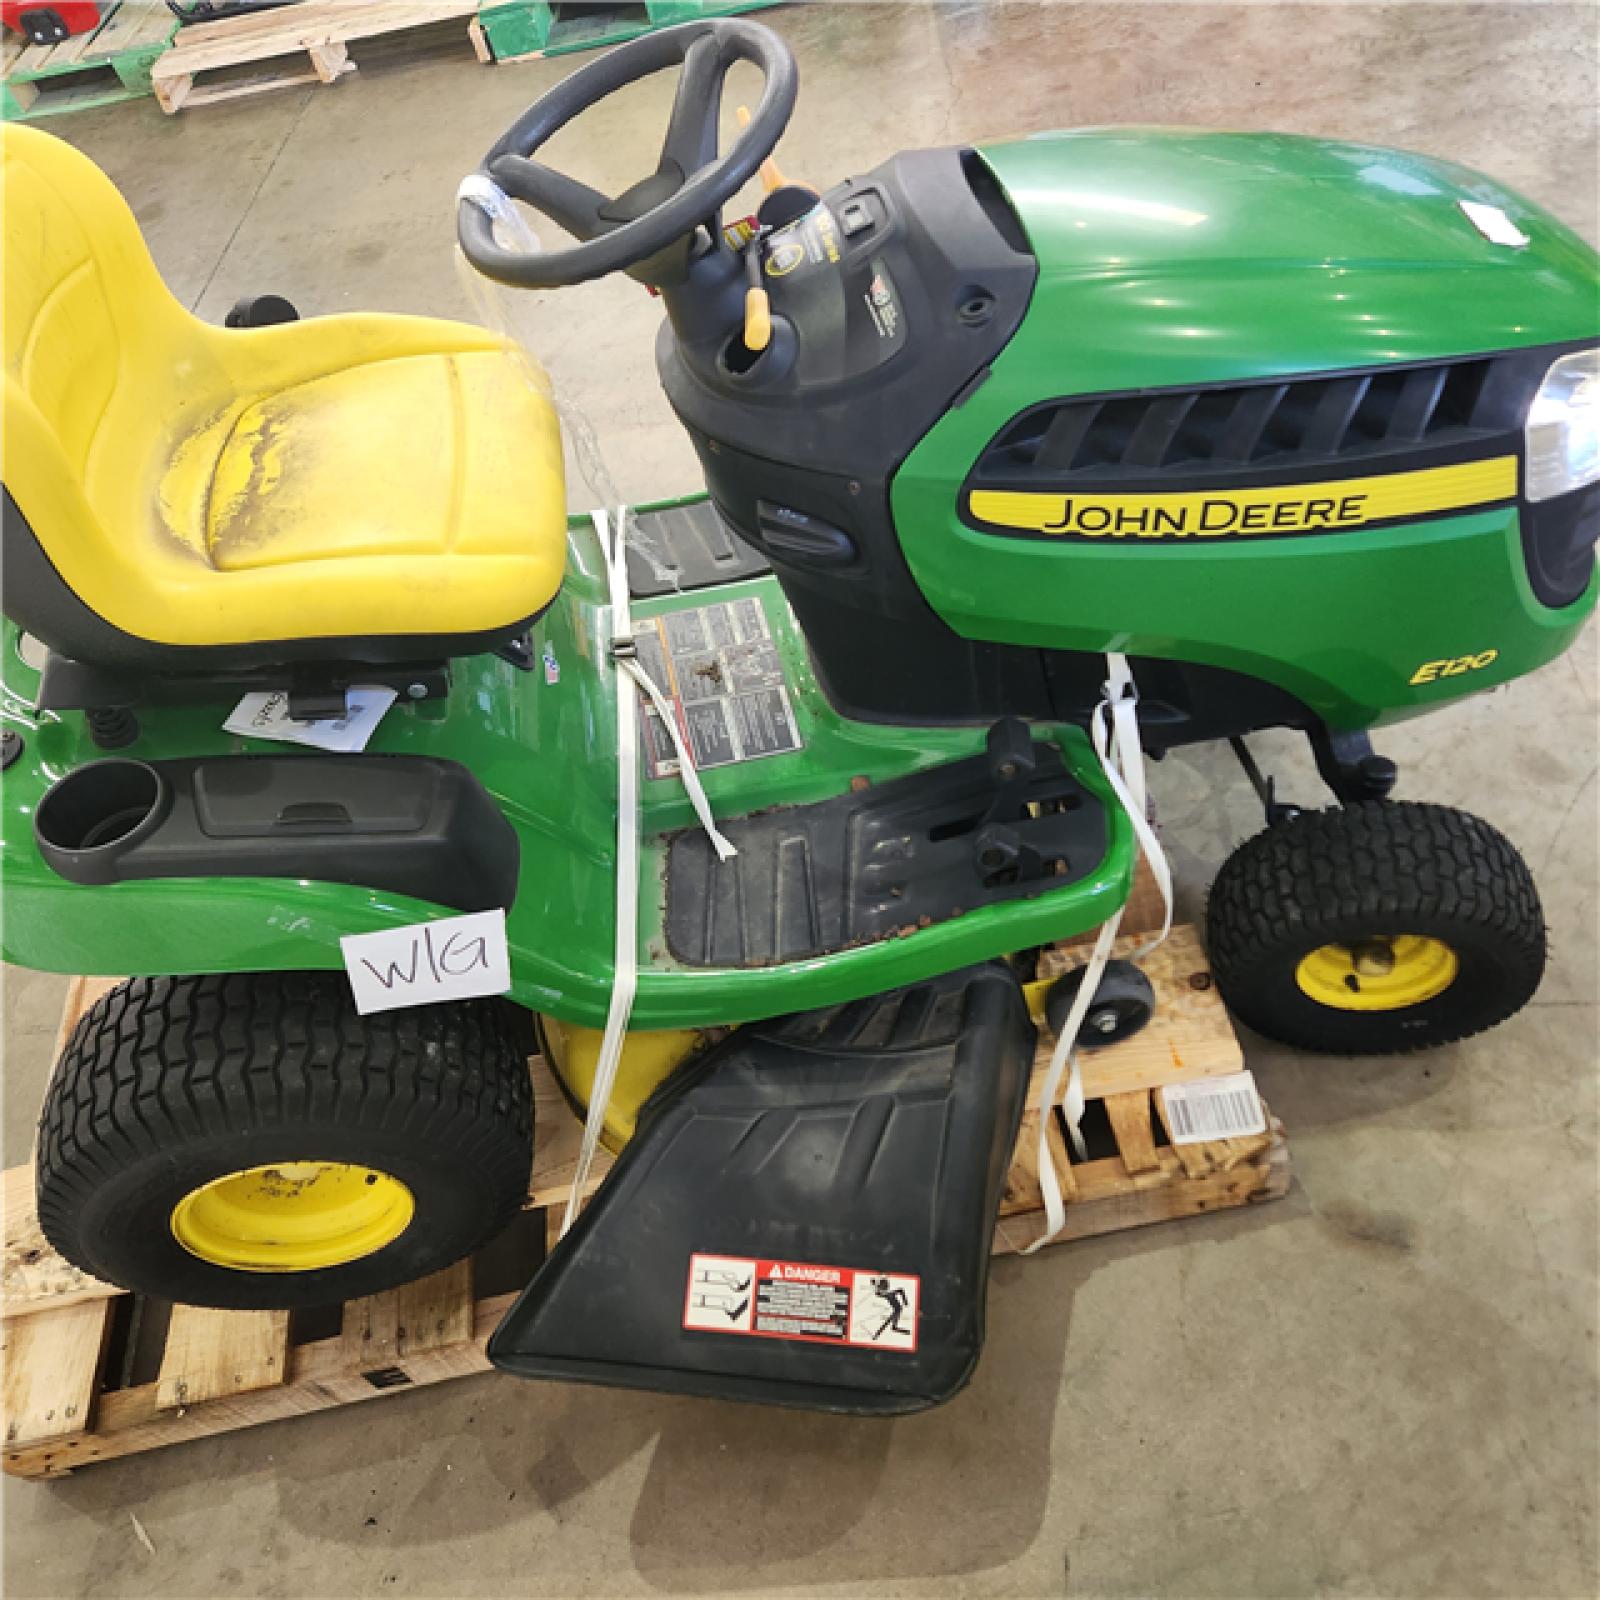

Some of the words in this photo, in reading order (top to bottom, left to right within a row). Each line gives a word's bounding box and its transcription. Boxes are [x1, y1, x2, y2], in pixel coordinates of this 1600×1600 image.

[1044, 499, 1187, 532] JOHN
[1199, 494, 1367, 532] DEERE
[1408, 649, 1498, 686] E120
[784, 1264, 841, 1284] DANGER
